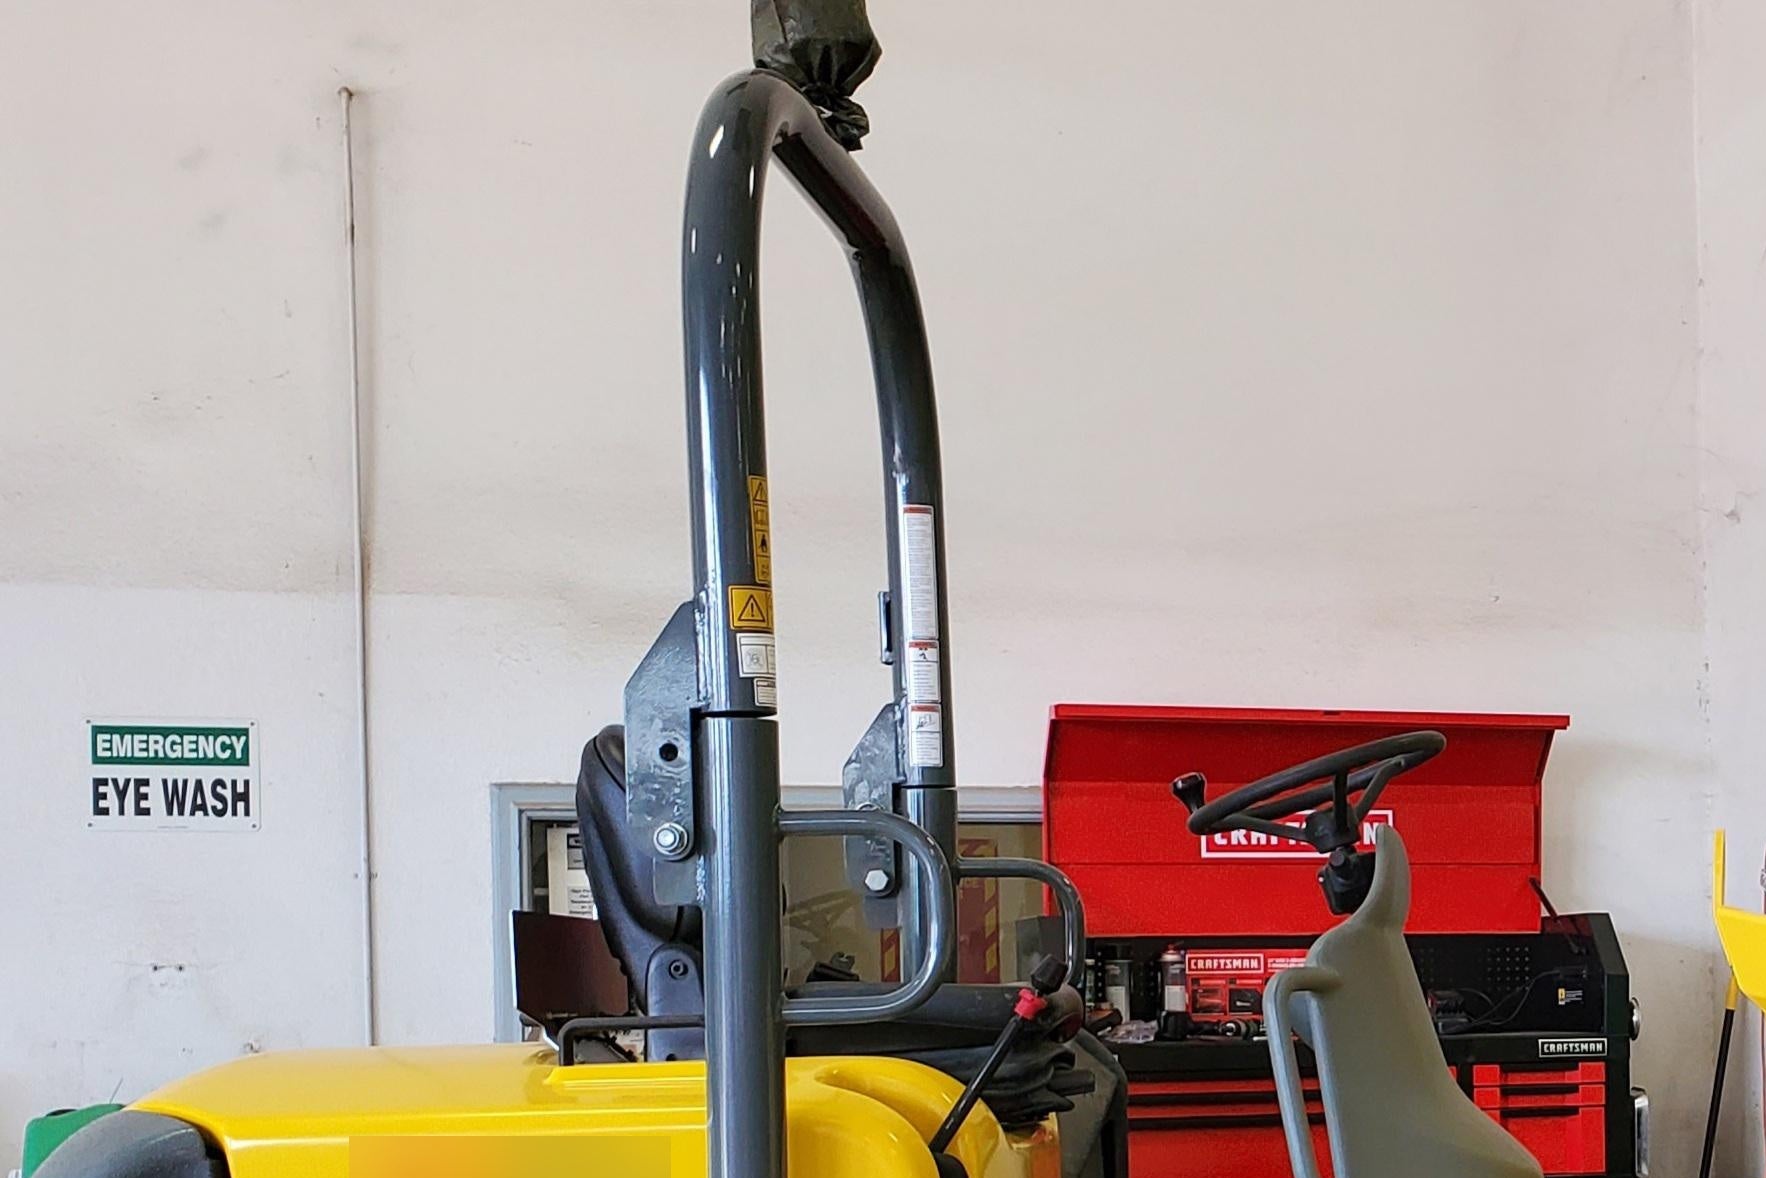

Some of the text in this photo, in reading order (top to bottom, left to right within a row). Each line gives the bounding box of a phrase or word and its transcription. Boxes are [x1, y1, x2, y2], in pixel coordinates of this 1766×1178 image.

[96, 733, 247, 760] EMERGENCY
[92, 777, 250, 818] EYE WASH
[1190, 958, 1259, 970] CRAFTSMAN
[1543, 1042, 1603, 1053] CRAFTSMAN
